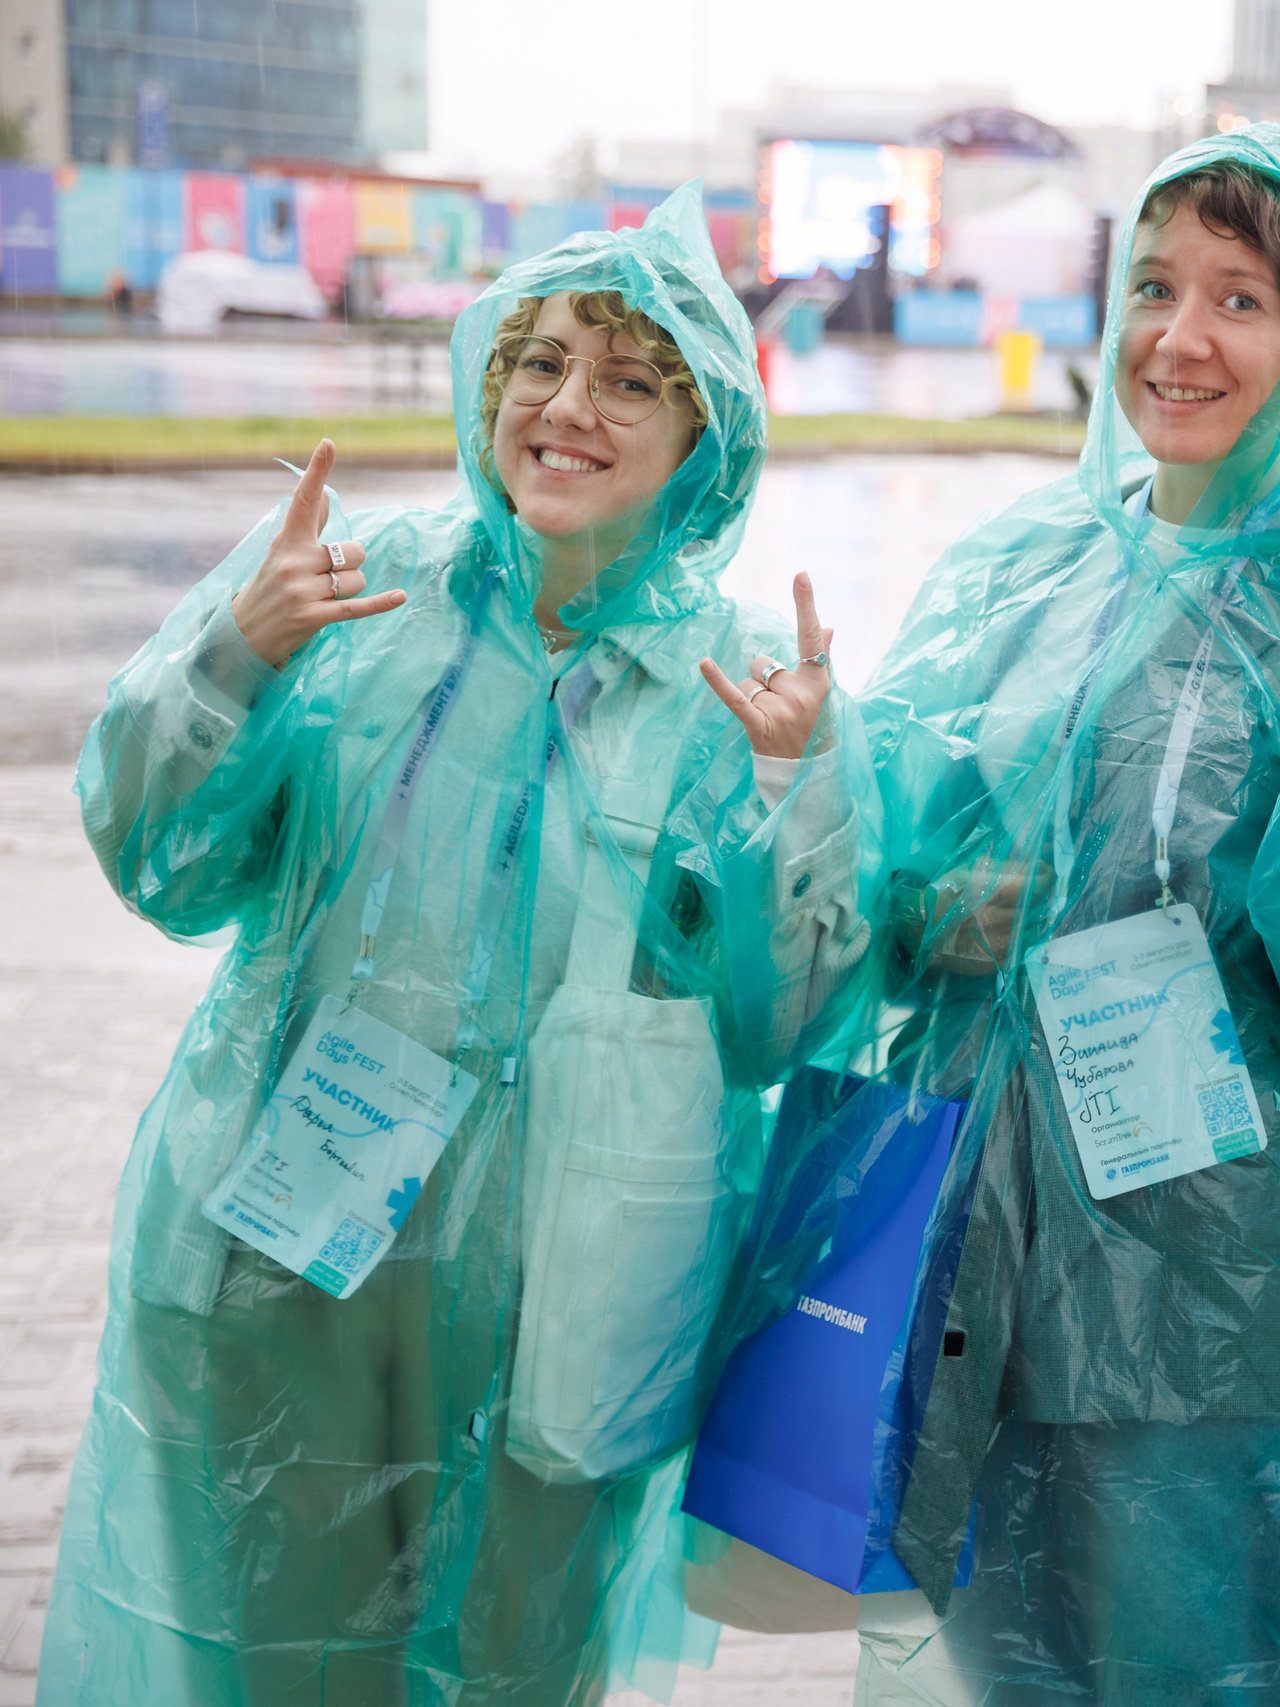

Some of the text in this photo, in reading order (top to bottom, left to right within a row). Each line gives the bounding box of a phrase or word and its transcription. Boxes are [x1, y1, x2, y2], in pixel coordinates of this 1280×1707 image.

[401, 688, 450, 787] МЕНЕДЖМЕНТ
[1049, 968, 1081, 988] Agile
[1050, 981, 1086, 1000] Days
[1059, 989, 1170, 1033] УЧАСТНИК
[316, 1041, 386, 1075] Days FEST
[320, 1031, 355, 1053] Agile
[290, 1095, 333, 1133] Дарья
[302, 1067, 394, 1135] УЧАСТНИК
[1080, 1085, 1121, 1123] JTI
[1091, 1114, 1140, 1133] Организатор
[1100, 1146, 1149, 1166] Генеральный
[1121, 1153, 1170, 1175] ГАЗПРОМБАНК
[797, 1294, 867, 1335] ГАЗПРОМБАНК
